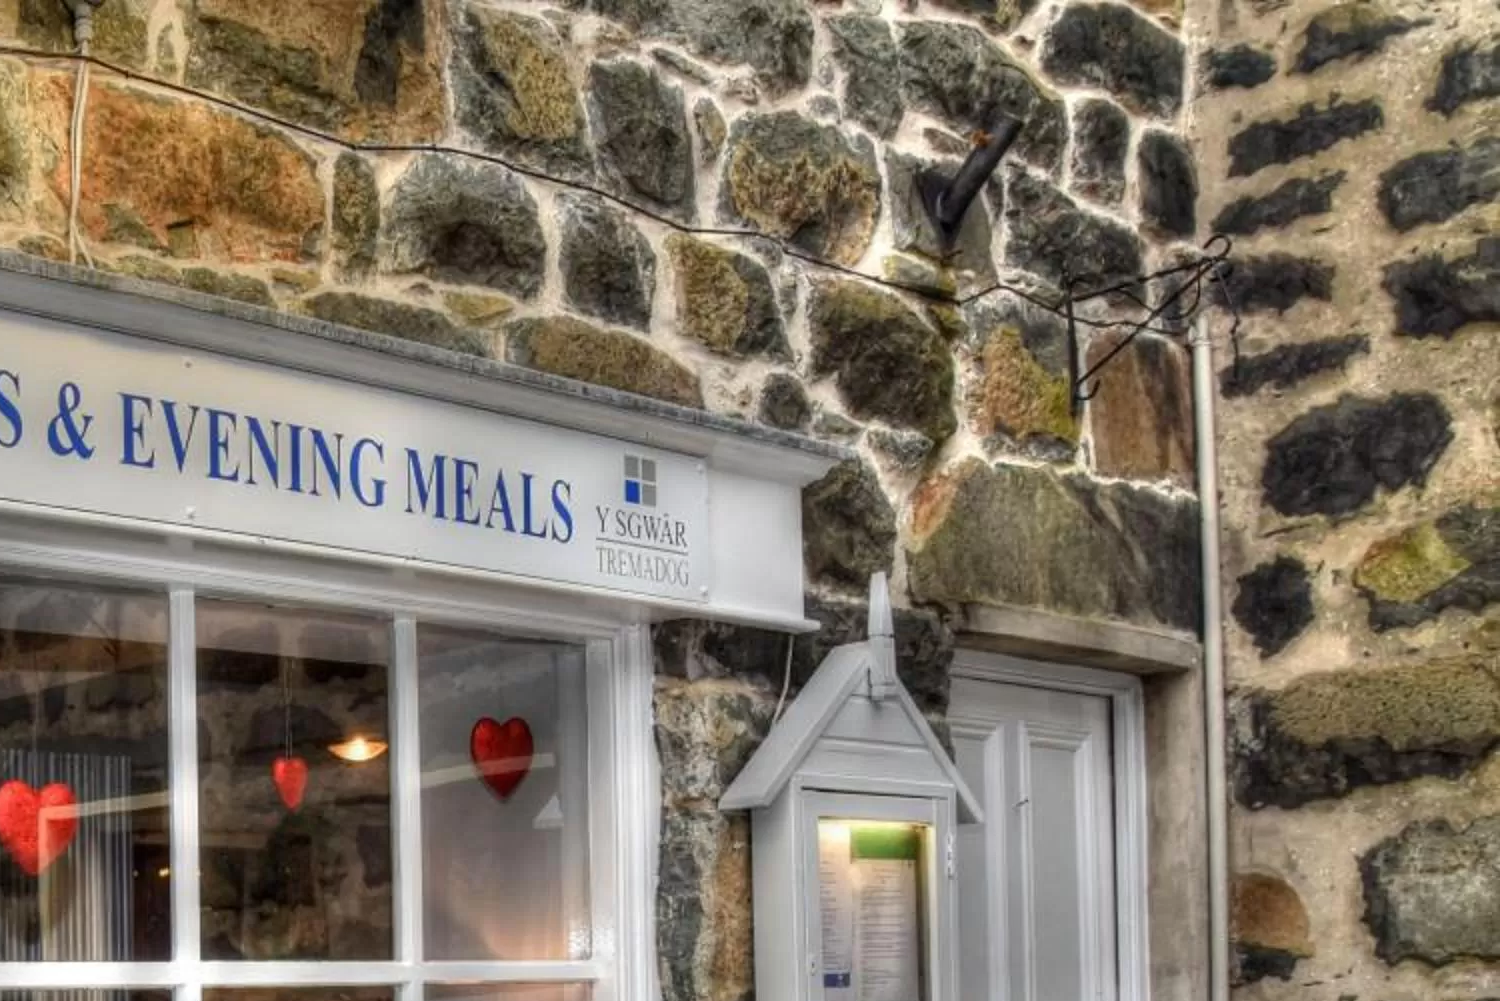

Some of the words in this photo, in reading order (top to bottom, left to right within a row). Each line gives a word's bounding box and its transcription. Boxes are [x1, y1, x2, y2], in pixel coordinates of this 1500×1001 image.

[46, 381, 96, 460] &
[118, 391, 388, 508] EVENING
[404, 447, 574, 544] MEALS
[595, 505, 611, 533] Y
[614, 508, 689, 548] SGWÂR
[595, 546, 690, 587] TREMADOG
